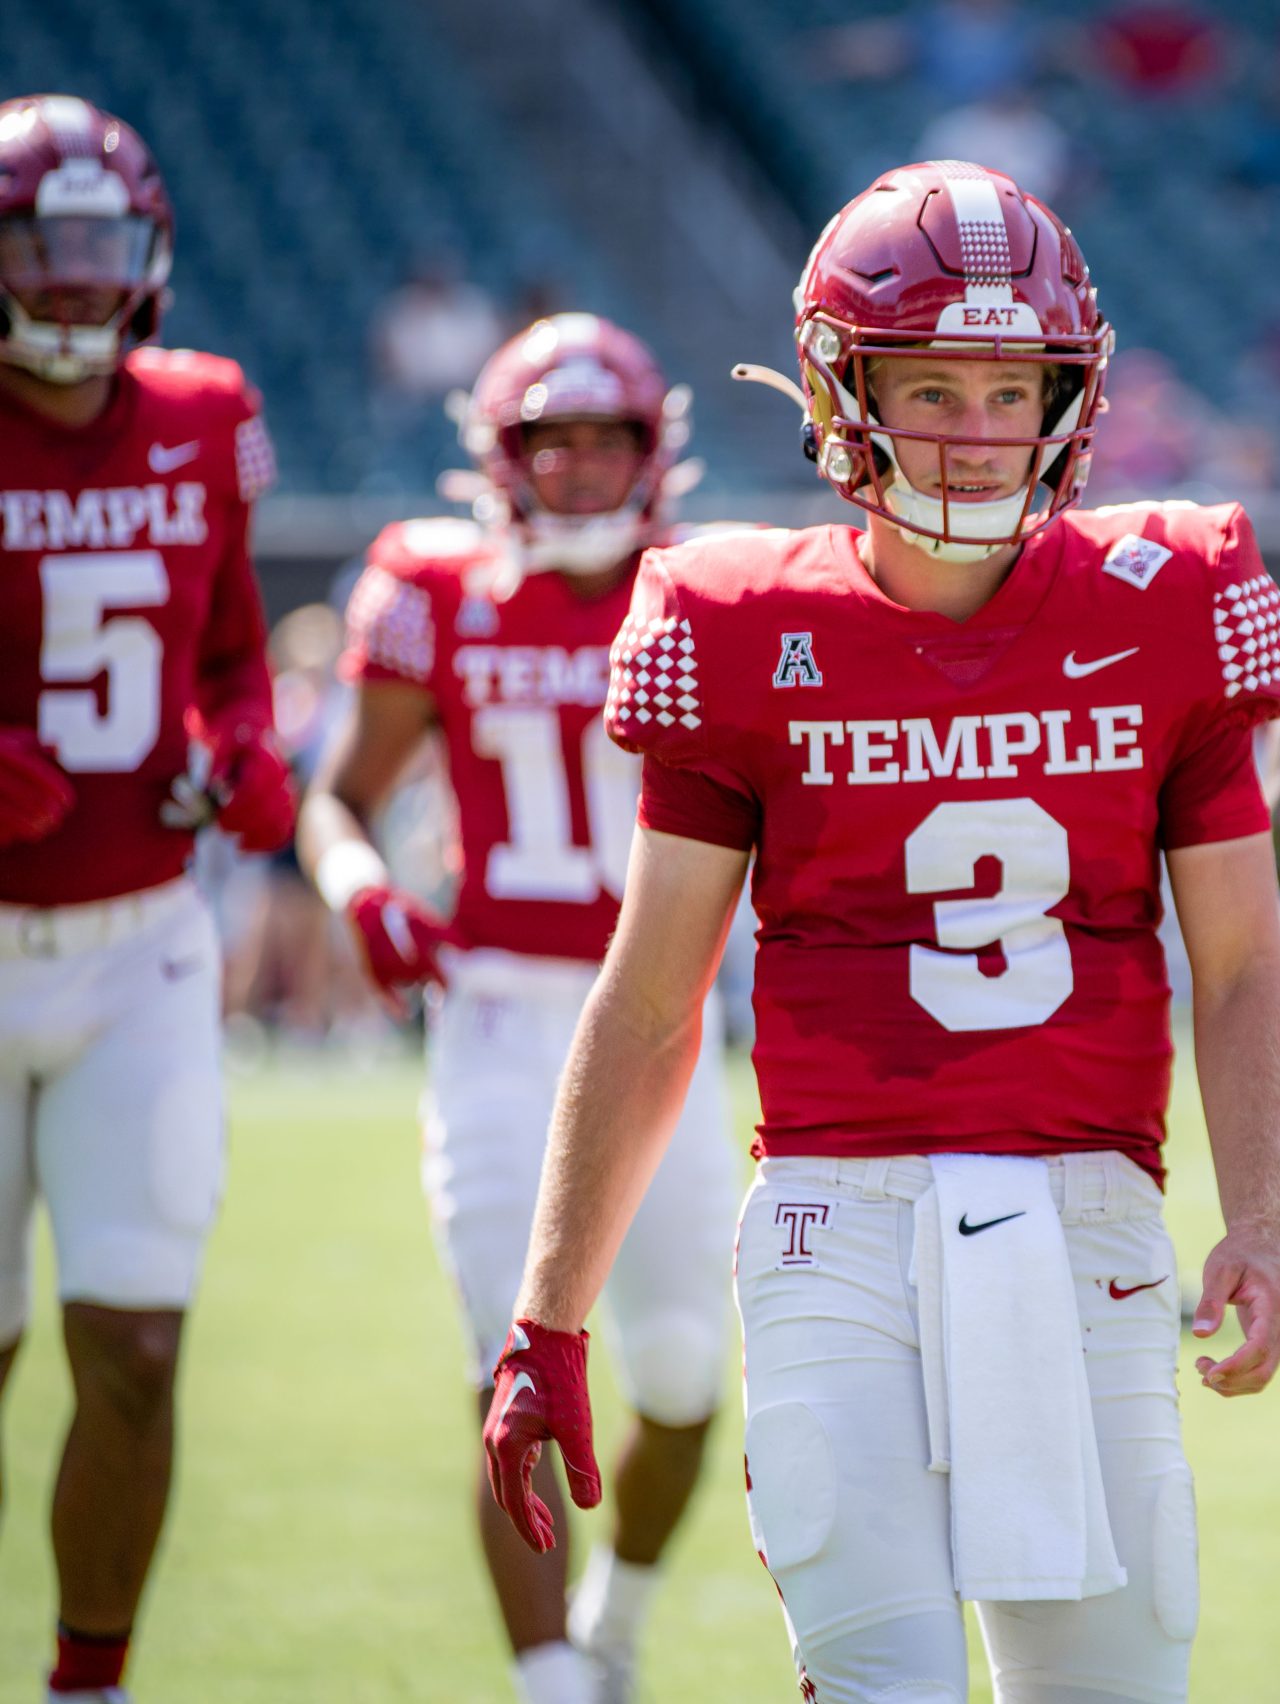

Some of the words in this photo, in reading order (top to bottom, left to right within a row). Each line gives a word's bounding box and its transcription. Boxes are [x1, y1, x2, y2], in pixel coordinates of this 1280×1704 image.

[963, 307, 1018, 326] EAT
[0, 482, 208, 551] EMPLE
[37, 549, 171, 774] 5
[452, 644, 612, 706] TEM
[773, 632, 823, 688] A
[788, 704, 1144, 786] TEMPLE
[904, 796, 1074, 1033] 3
[774, 1202, 831, 1266] T
